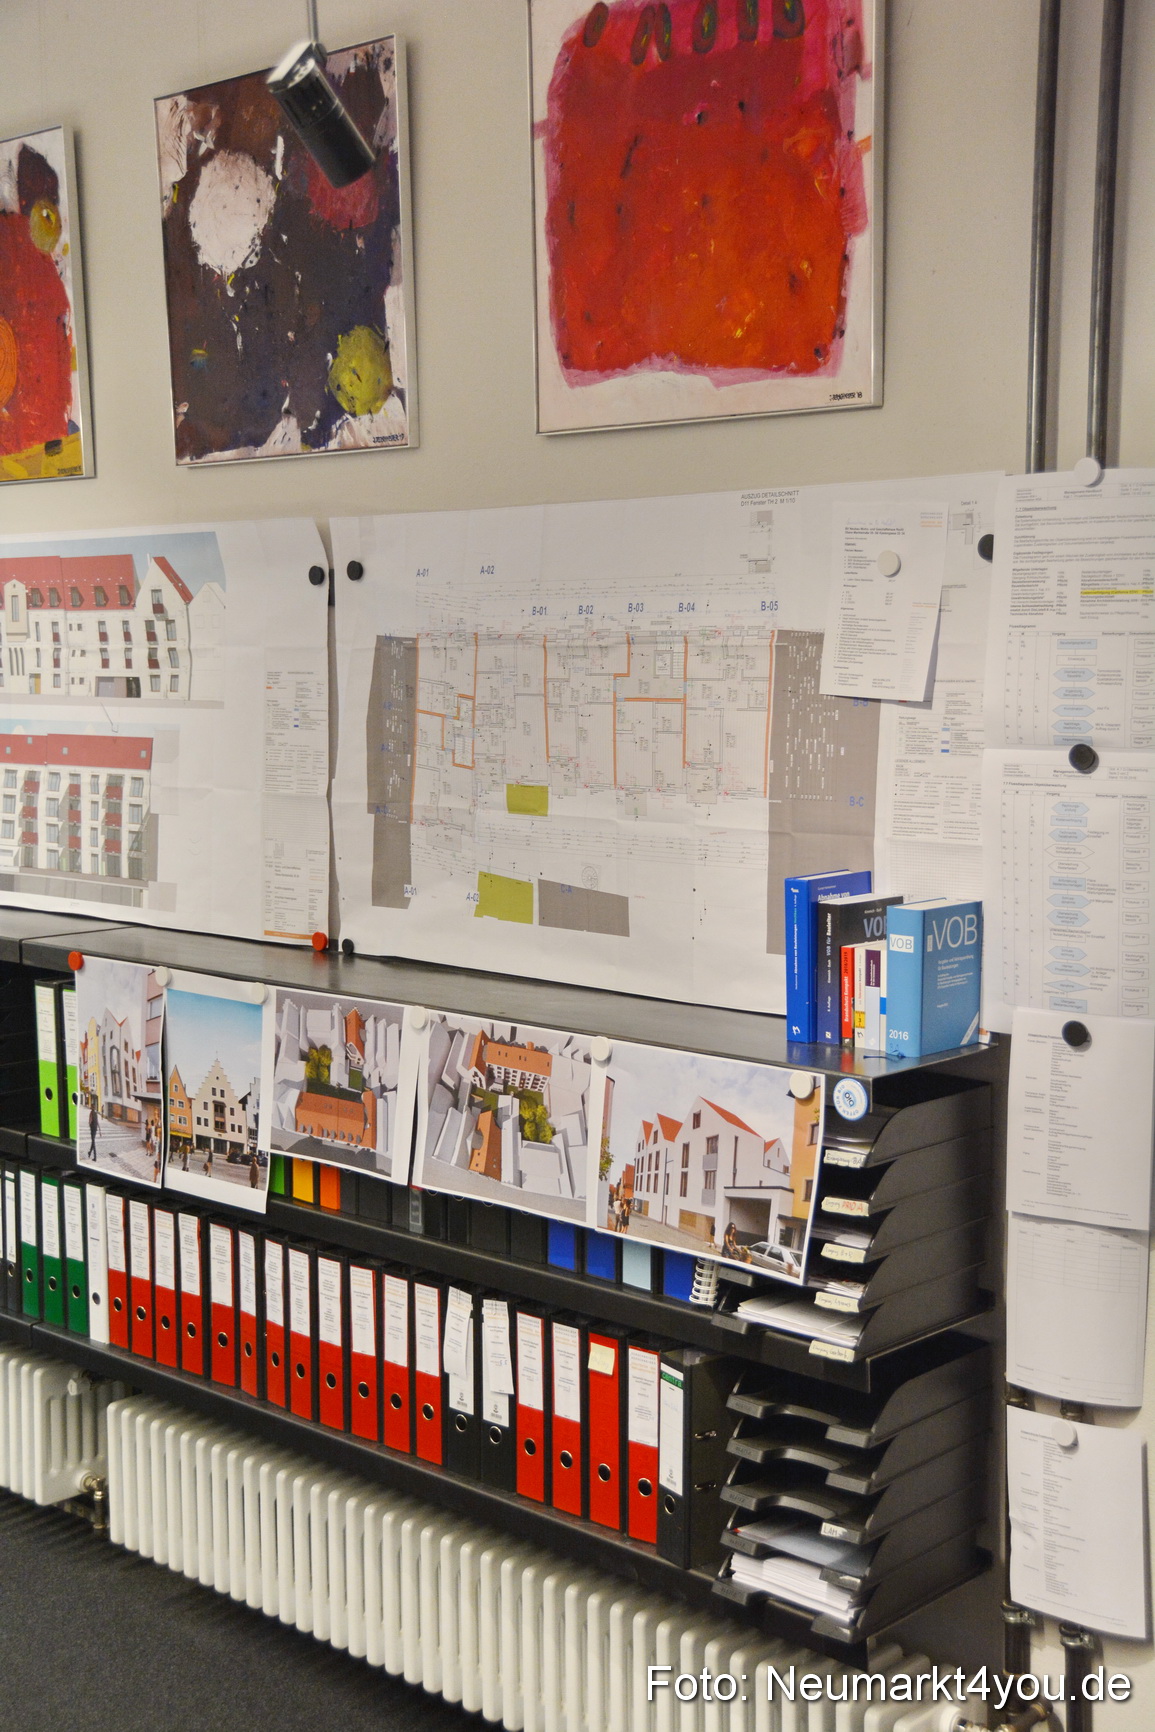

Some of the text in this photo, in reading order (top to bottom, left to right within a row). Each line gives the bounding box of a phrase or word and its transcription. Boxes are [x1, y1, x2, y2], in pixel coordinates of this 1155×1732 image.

[416, 568, 429, 578] A-01
[480, 565, 494, 574] A-02
[532, 606, 547, 616] B-01
[578, 605, 594, 615] B-02
[628, 602, 644, 612] B-03
[678, 602, 695, 612] B-04
[761, 601, 778, 611] B-05
[849, 796, 864, 807] B-C
[863, 916, 887, 938] VO
[932, 914, 978, 950] VOB
[890, 937, 913, 950] VOB
[889, 1029, 909, 1040] 2016
[662, 1372, 682, 1388] centra
